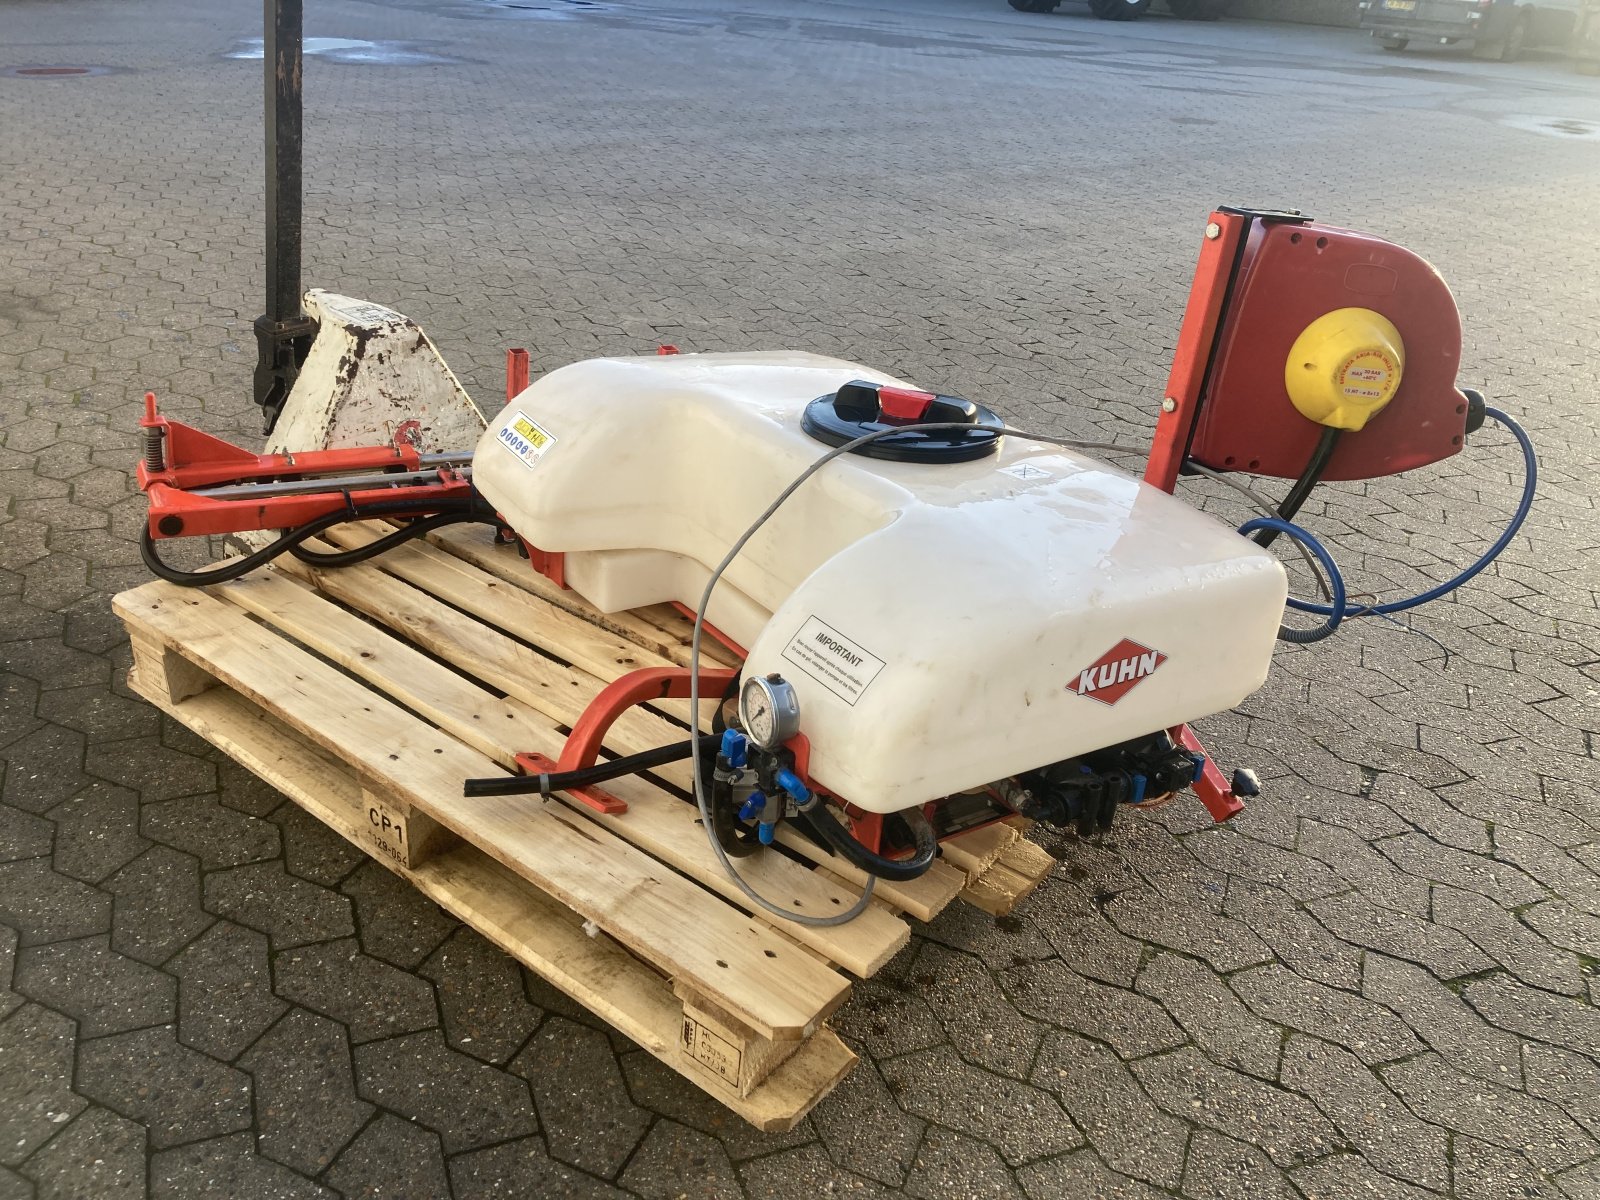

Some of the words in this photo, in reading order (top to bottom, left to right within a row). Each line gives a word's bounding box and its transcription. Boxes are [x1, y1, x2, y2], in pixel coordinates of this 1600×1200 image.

[816, 632, 863, 667] IMPORTANT
[1077, 650, 1158, 695] KUHN
[369, 808, 403, 844] CP1
